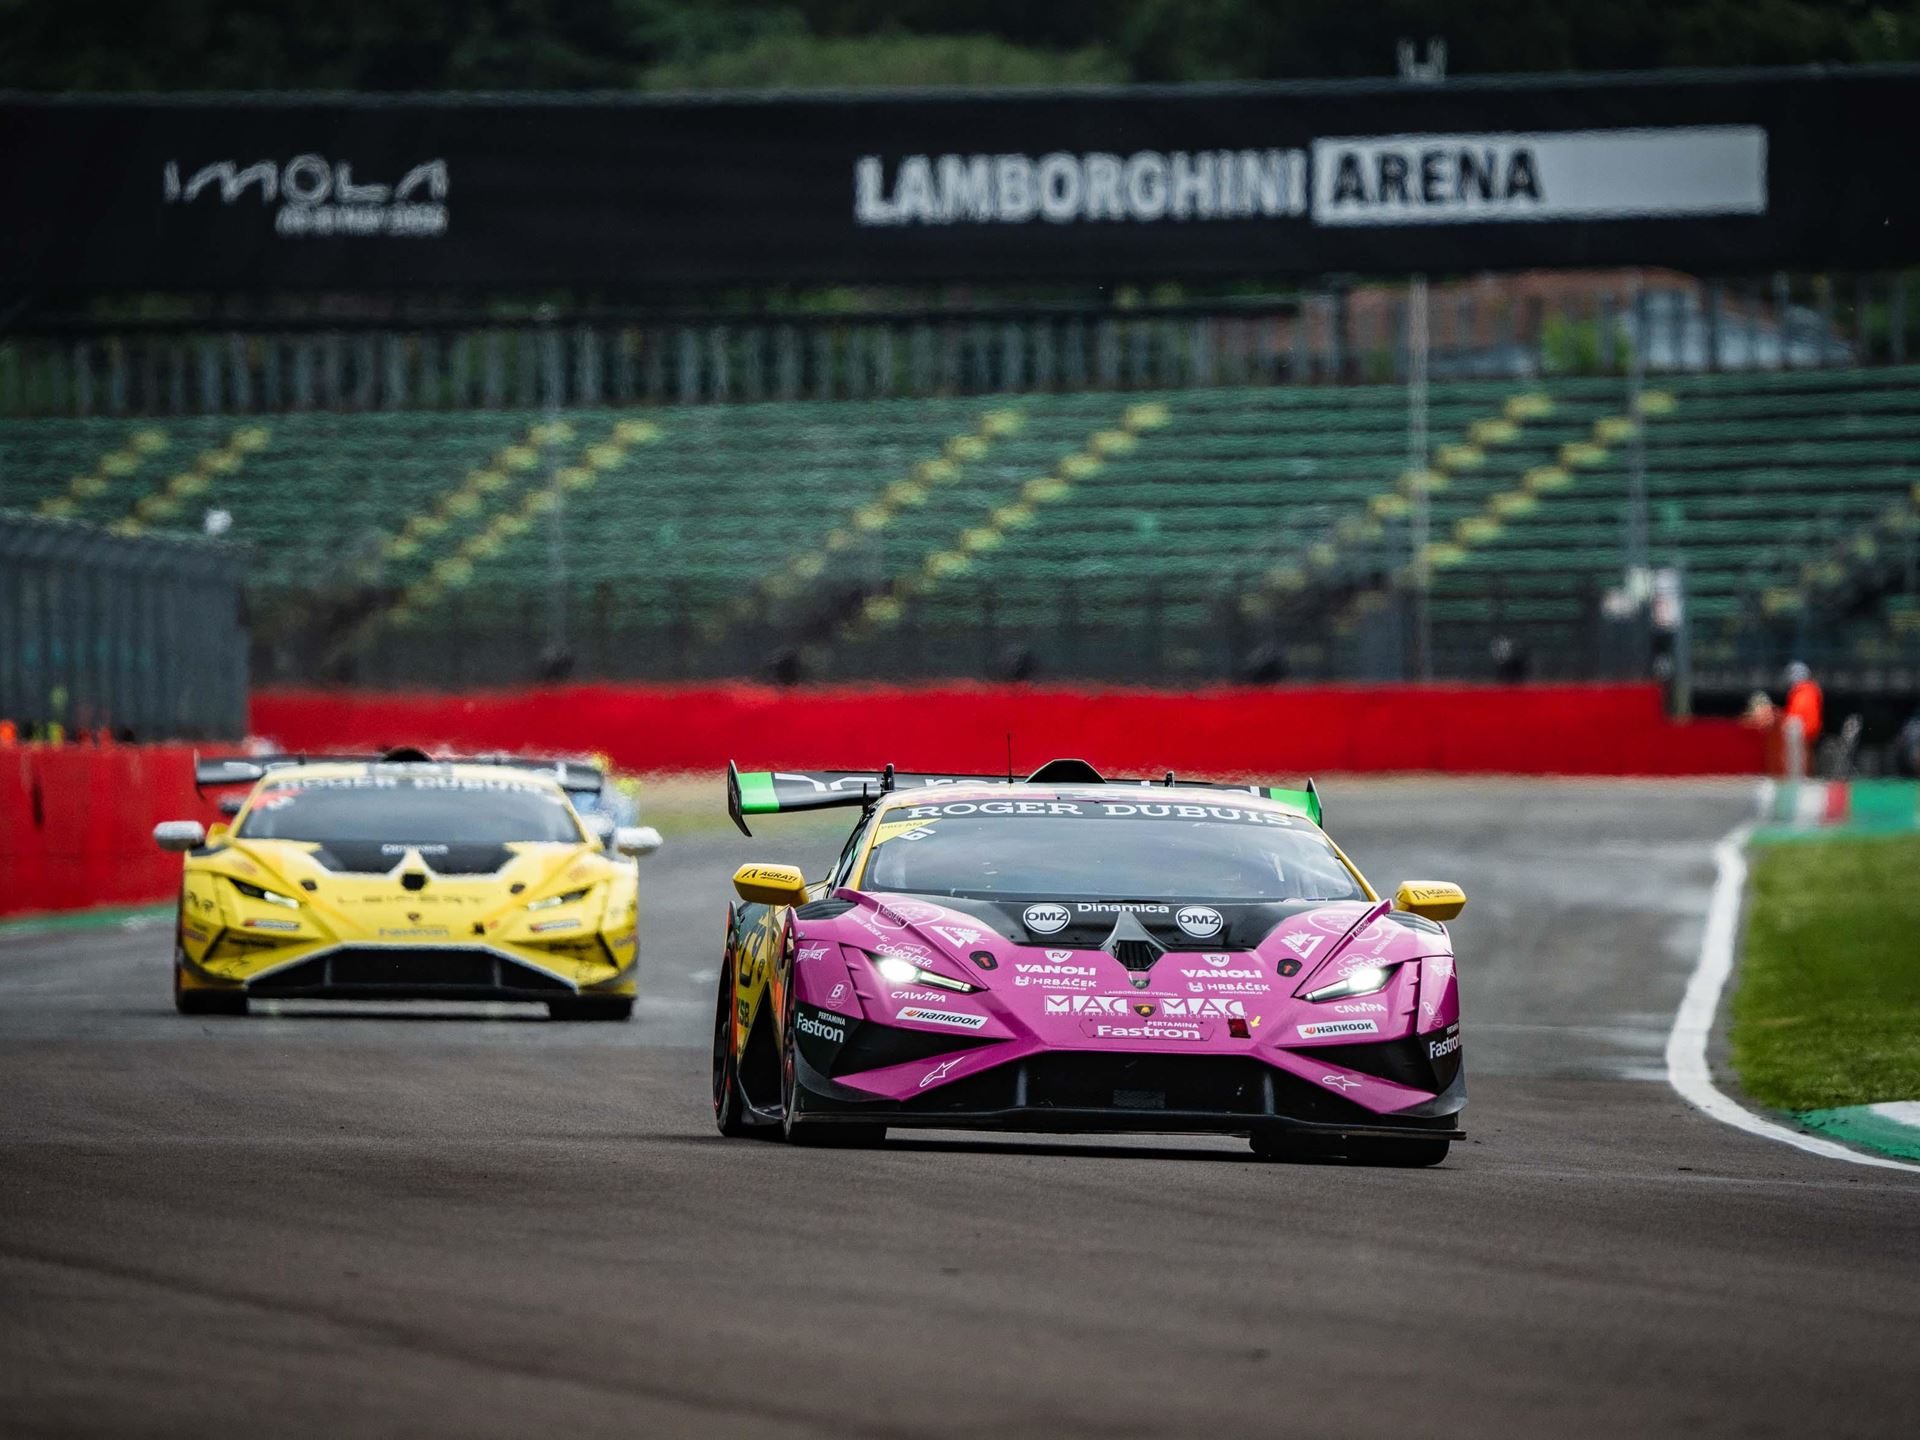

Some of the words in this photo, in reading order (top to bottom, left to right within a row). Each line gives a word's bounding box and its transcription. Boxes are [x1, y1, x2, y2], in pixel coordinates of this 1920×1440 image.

[164, 153, 449, 202] IMOLA
[855, 150, 1306, 224] LAMBORGHINI
[1333, 147, 1545, 204] ARENA
[907, 801, 1083, 818] ROGER
[1102, 803, 1293, 826] DUBUIS
[759, 871, 799, 881] AGRATI
[1077, 903, 1170, 913] Dinamica
[1027, 912, 1068, 921] OMZ
[1179, 914, 1221, 925] OMZ
[1015, 964, 1097, 976] VANOLI
[1180, 969, 1263, 979] VANOLI
[818, 1011, 846, 1027] PERTAMINA
[1147, 1021, 1199, 1029] PERTAMINA
[796, 1012, 845, 1043] Fastron
[1097, 1025, 1201, 1039] Fastron
